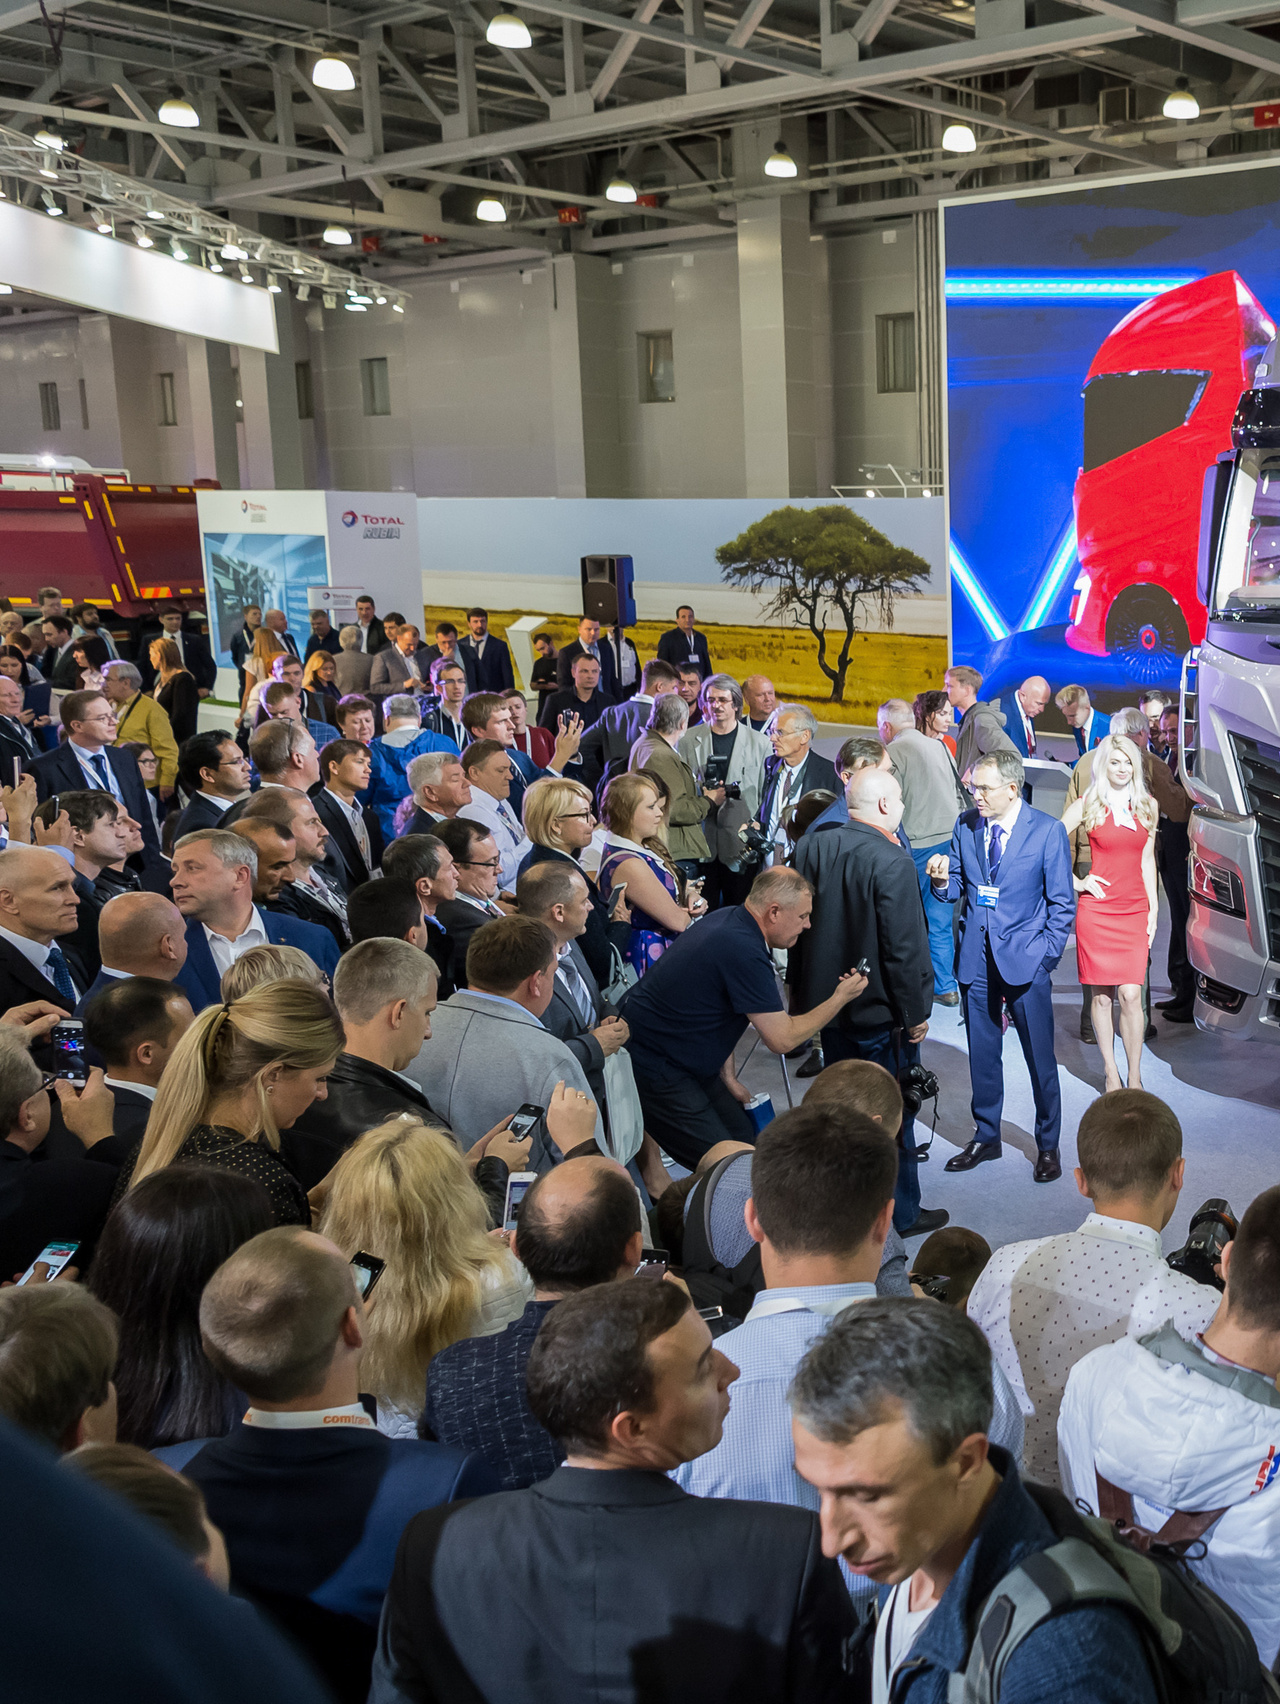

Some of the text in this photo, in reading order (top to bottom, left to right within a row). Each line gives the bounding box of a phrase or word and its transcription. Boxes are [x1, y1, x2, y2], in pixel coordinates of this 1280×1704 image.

[361, 514, 405, 525] TOTAL
[363, 527, 400, 539] RUBIA
[322, 1414, 371, 1425] comtrans
